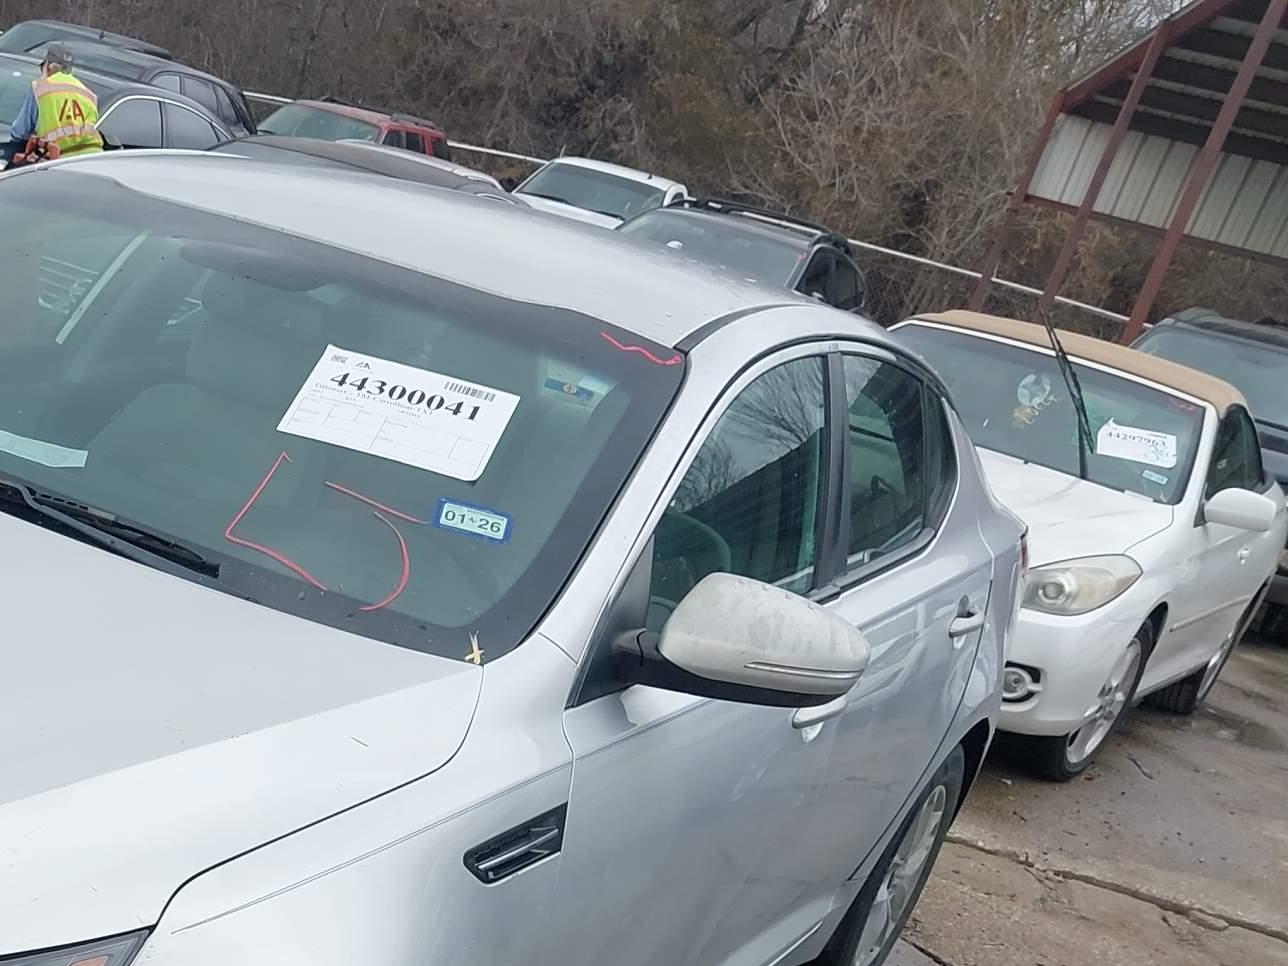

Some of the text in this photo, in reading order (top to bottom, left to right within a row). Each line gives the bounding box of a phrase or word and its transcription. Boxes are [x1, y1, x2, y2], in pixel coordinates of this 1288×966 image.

[330, 372, 481, 421] 44300041
[444, 510, 502, 533] 01 26
